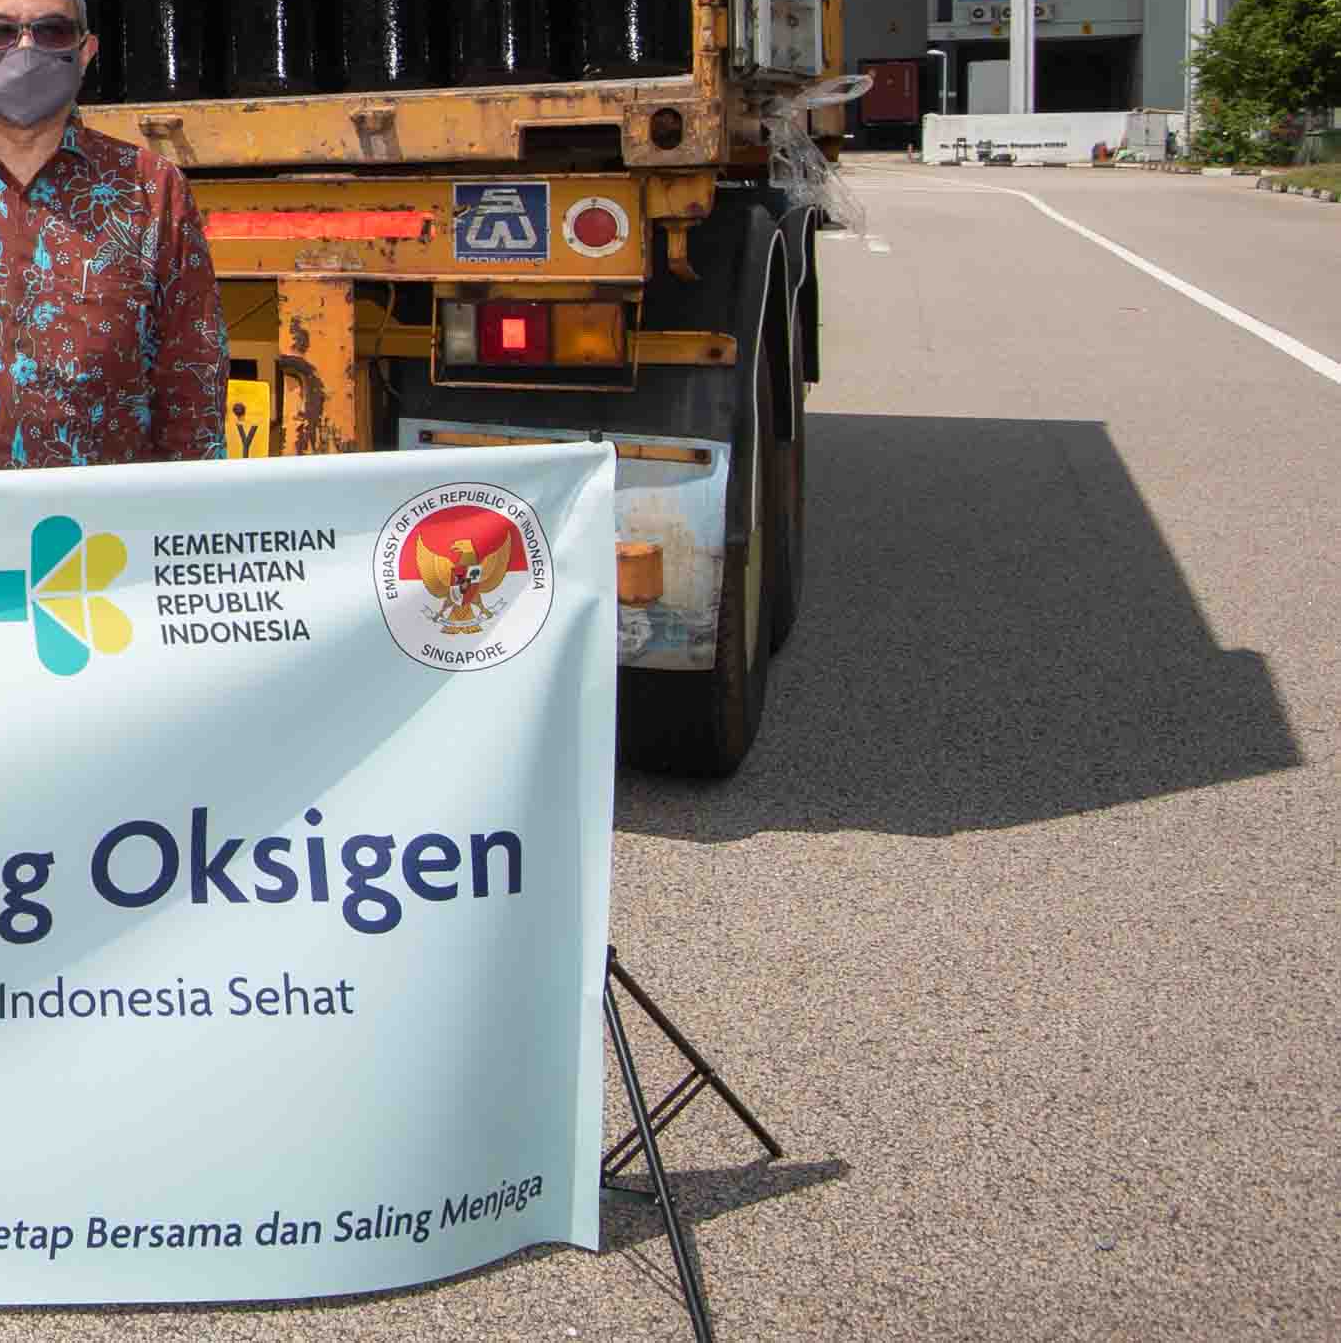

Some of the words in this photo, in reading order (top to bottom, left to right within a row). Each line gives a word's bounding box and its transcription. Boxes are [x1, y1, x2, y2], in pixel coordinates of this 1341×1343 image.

[153, 528, 337, 558] KEMENTERIAN
[382, 534, 400, 601] EMBASSY
[395, 517, 413, 533] OF
[409, 497, 438, 516] THE
[439, 490, 506, 509] REPUBLIC
[507, 503, 527, 520] OF
[520, 519, 546, 591] INDONESIA
[154, 559, 306, 587] KESEHATAN
[157, 589, 285, 617] REPUBLIK
[160, 618, 311, 646] INDONESIA
[421, 641, 508, 665] SINGAPORE
[90, 806, 524, 935] Oksigen
[227, 971, 355, 1016] Sehat
[86, 1216, 242, 1250] Bersama
[254, 1210, 322, 1248] dan
[333, 1203, 432, 1244] Saling
[439, 1174, 543, 1230] Menjaga
